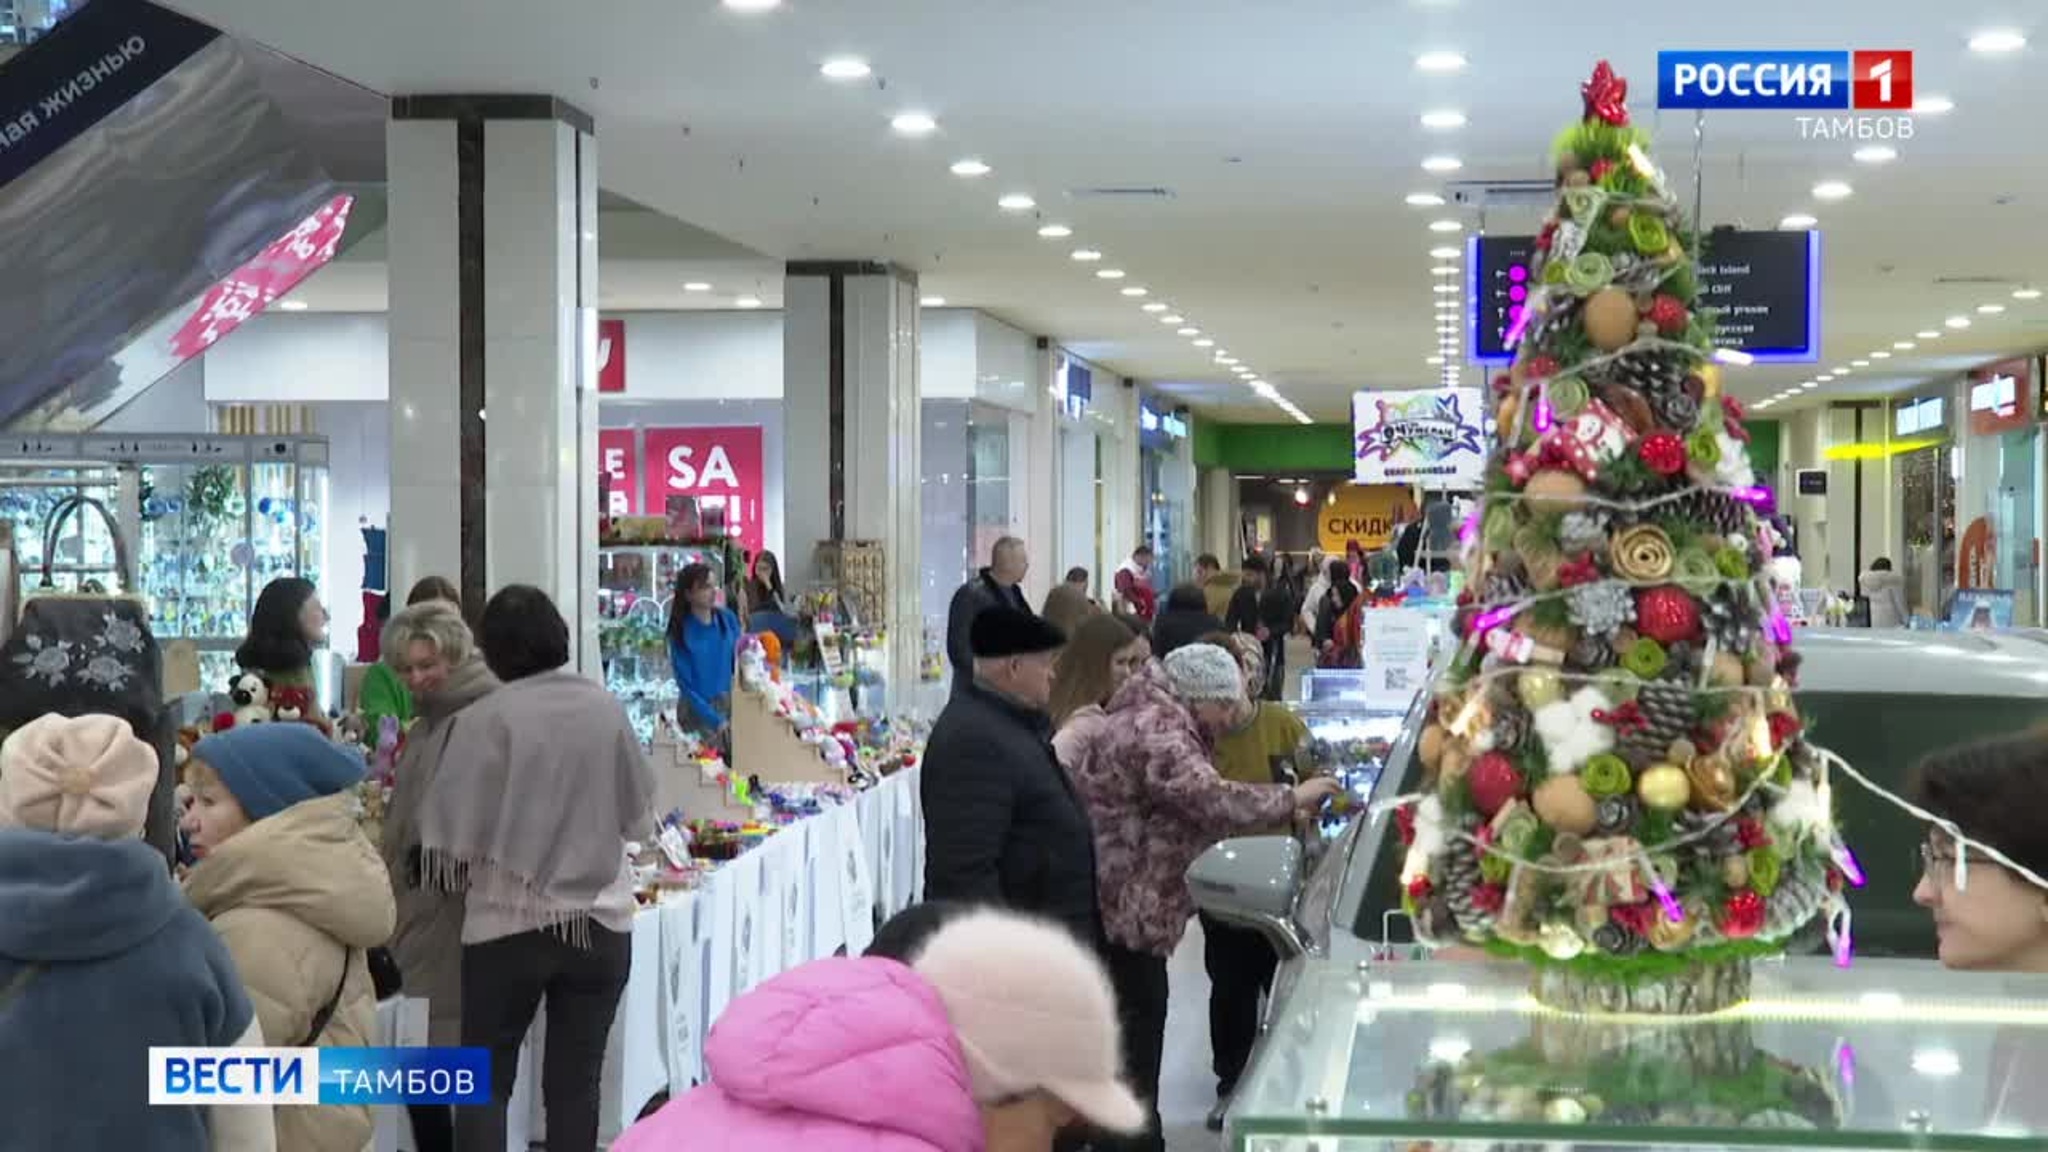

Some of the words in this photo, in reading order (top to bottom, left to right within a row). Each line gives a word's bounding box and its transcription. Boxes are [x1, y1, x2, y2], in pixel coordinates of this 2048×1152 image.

[40, 35, 146, 120] жизнью
[1719, 264, 1750, 274] Island
[668, 445, 740, 489] SA
[1328, 517, 1391, 537] СКИДК
